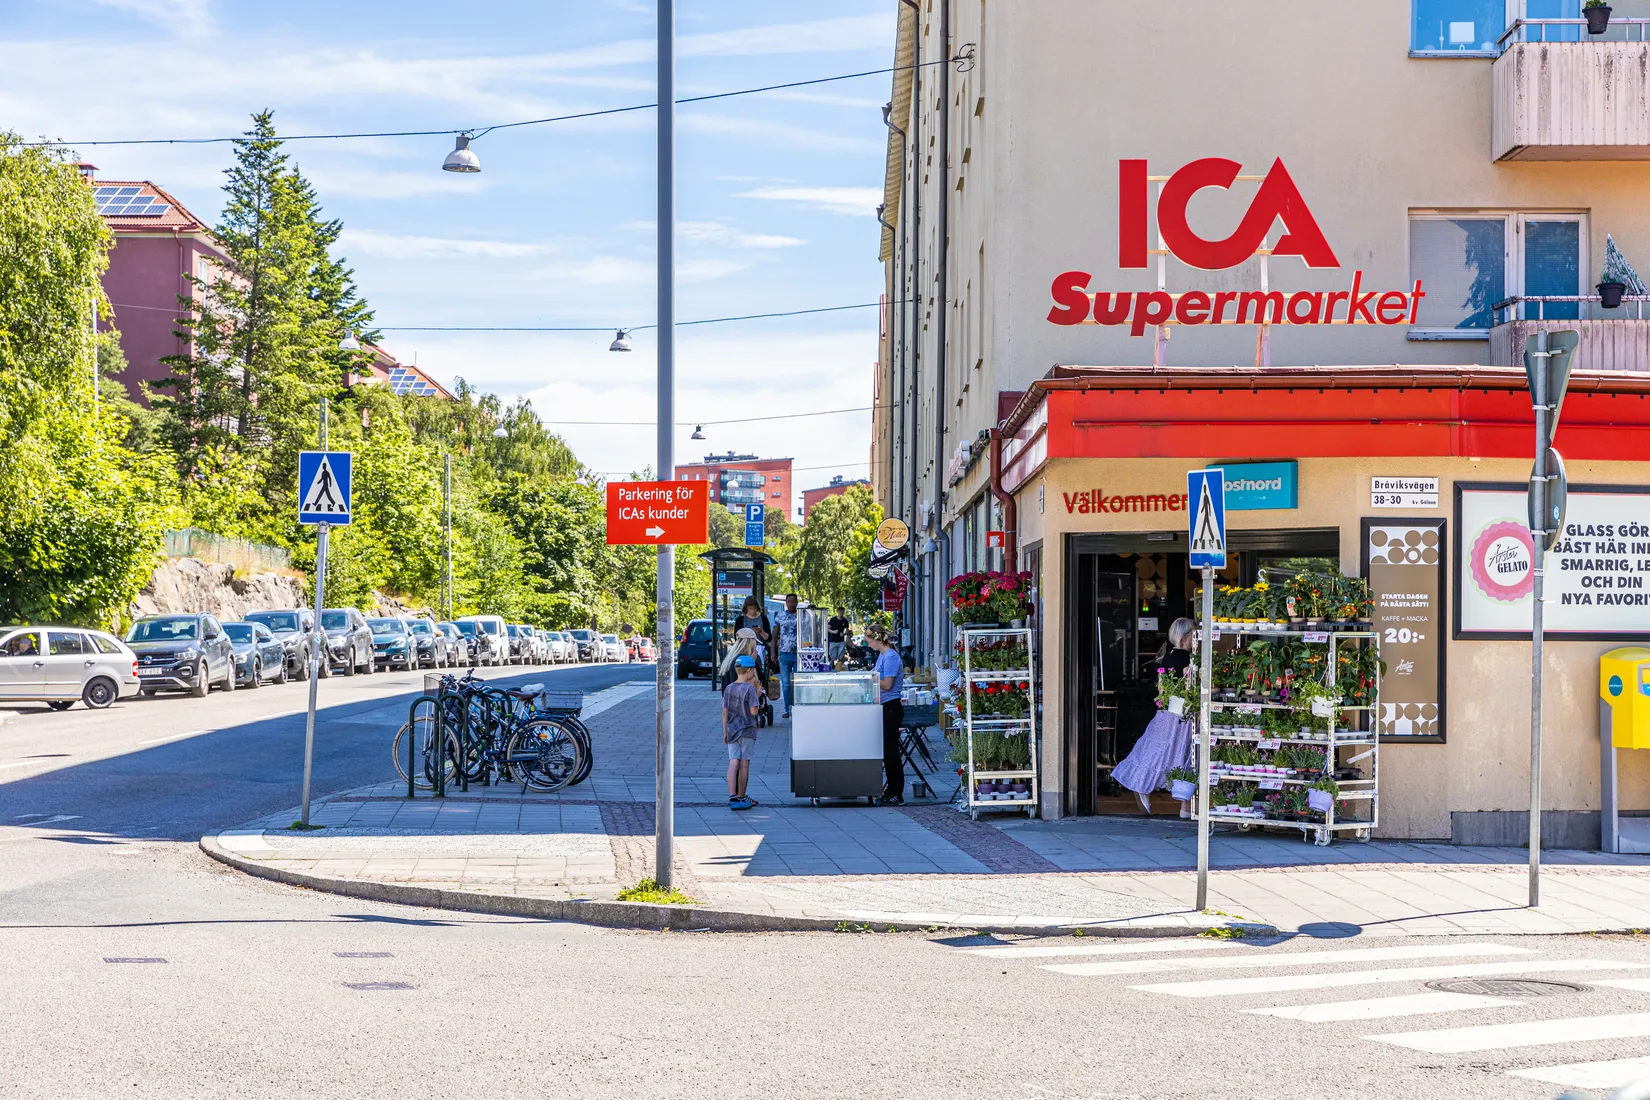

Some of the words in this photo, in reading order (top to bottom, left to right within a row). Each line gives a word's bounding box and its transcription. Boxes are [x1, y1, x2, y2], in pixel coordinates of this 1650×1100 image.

[1119, 156, 1341, 270] ICA
[1046, 270, 1426, 337] Supermarket
[1224, 477, 1282, 491] ostnord
[1374, 480, 1434, 492] Bråviksvägen
[619, 487, 673, 504] Parkering
[676, 486, 694, 500] för
[1374, 495, 1402, 504] 38-30
[619, 507, 645, 520] ICAs
[648, 505, 689, 519] kunder
[750, 506, 761, 520] P
[1566, 524, 1614, 537] GLASS
[1618, 521, 1650, 537] GÖR
[1553, 537, 1591, 553] BÄST
[1595, 538, 1627, 554] HÄR
[1497, 560, 1528, 573] GELATO
[1560, 558, 1634, 573] SMARRIG,
[1581, 575, 1613, 588] OCH
[1617, 576, 1643, 588] DIN
[1561, 593, 1592, 605] NYA
[1596, 593, 1650, 605] FAVORI
[1384, 627, 1425, 643] 20:-
